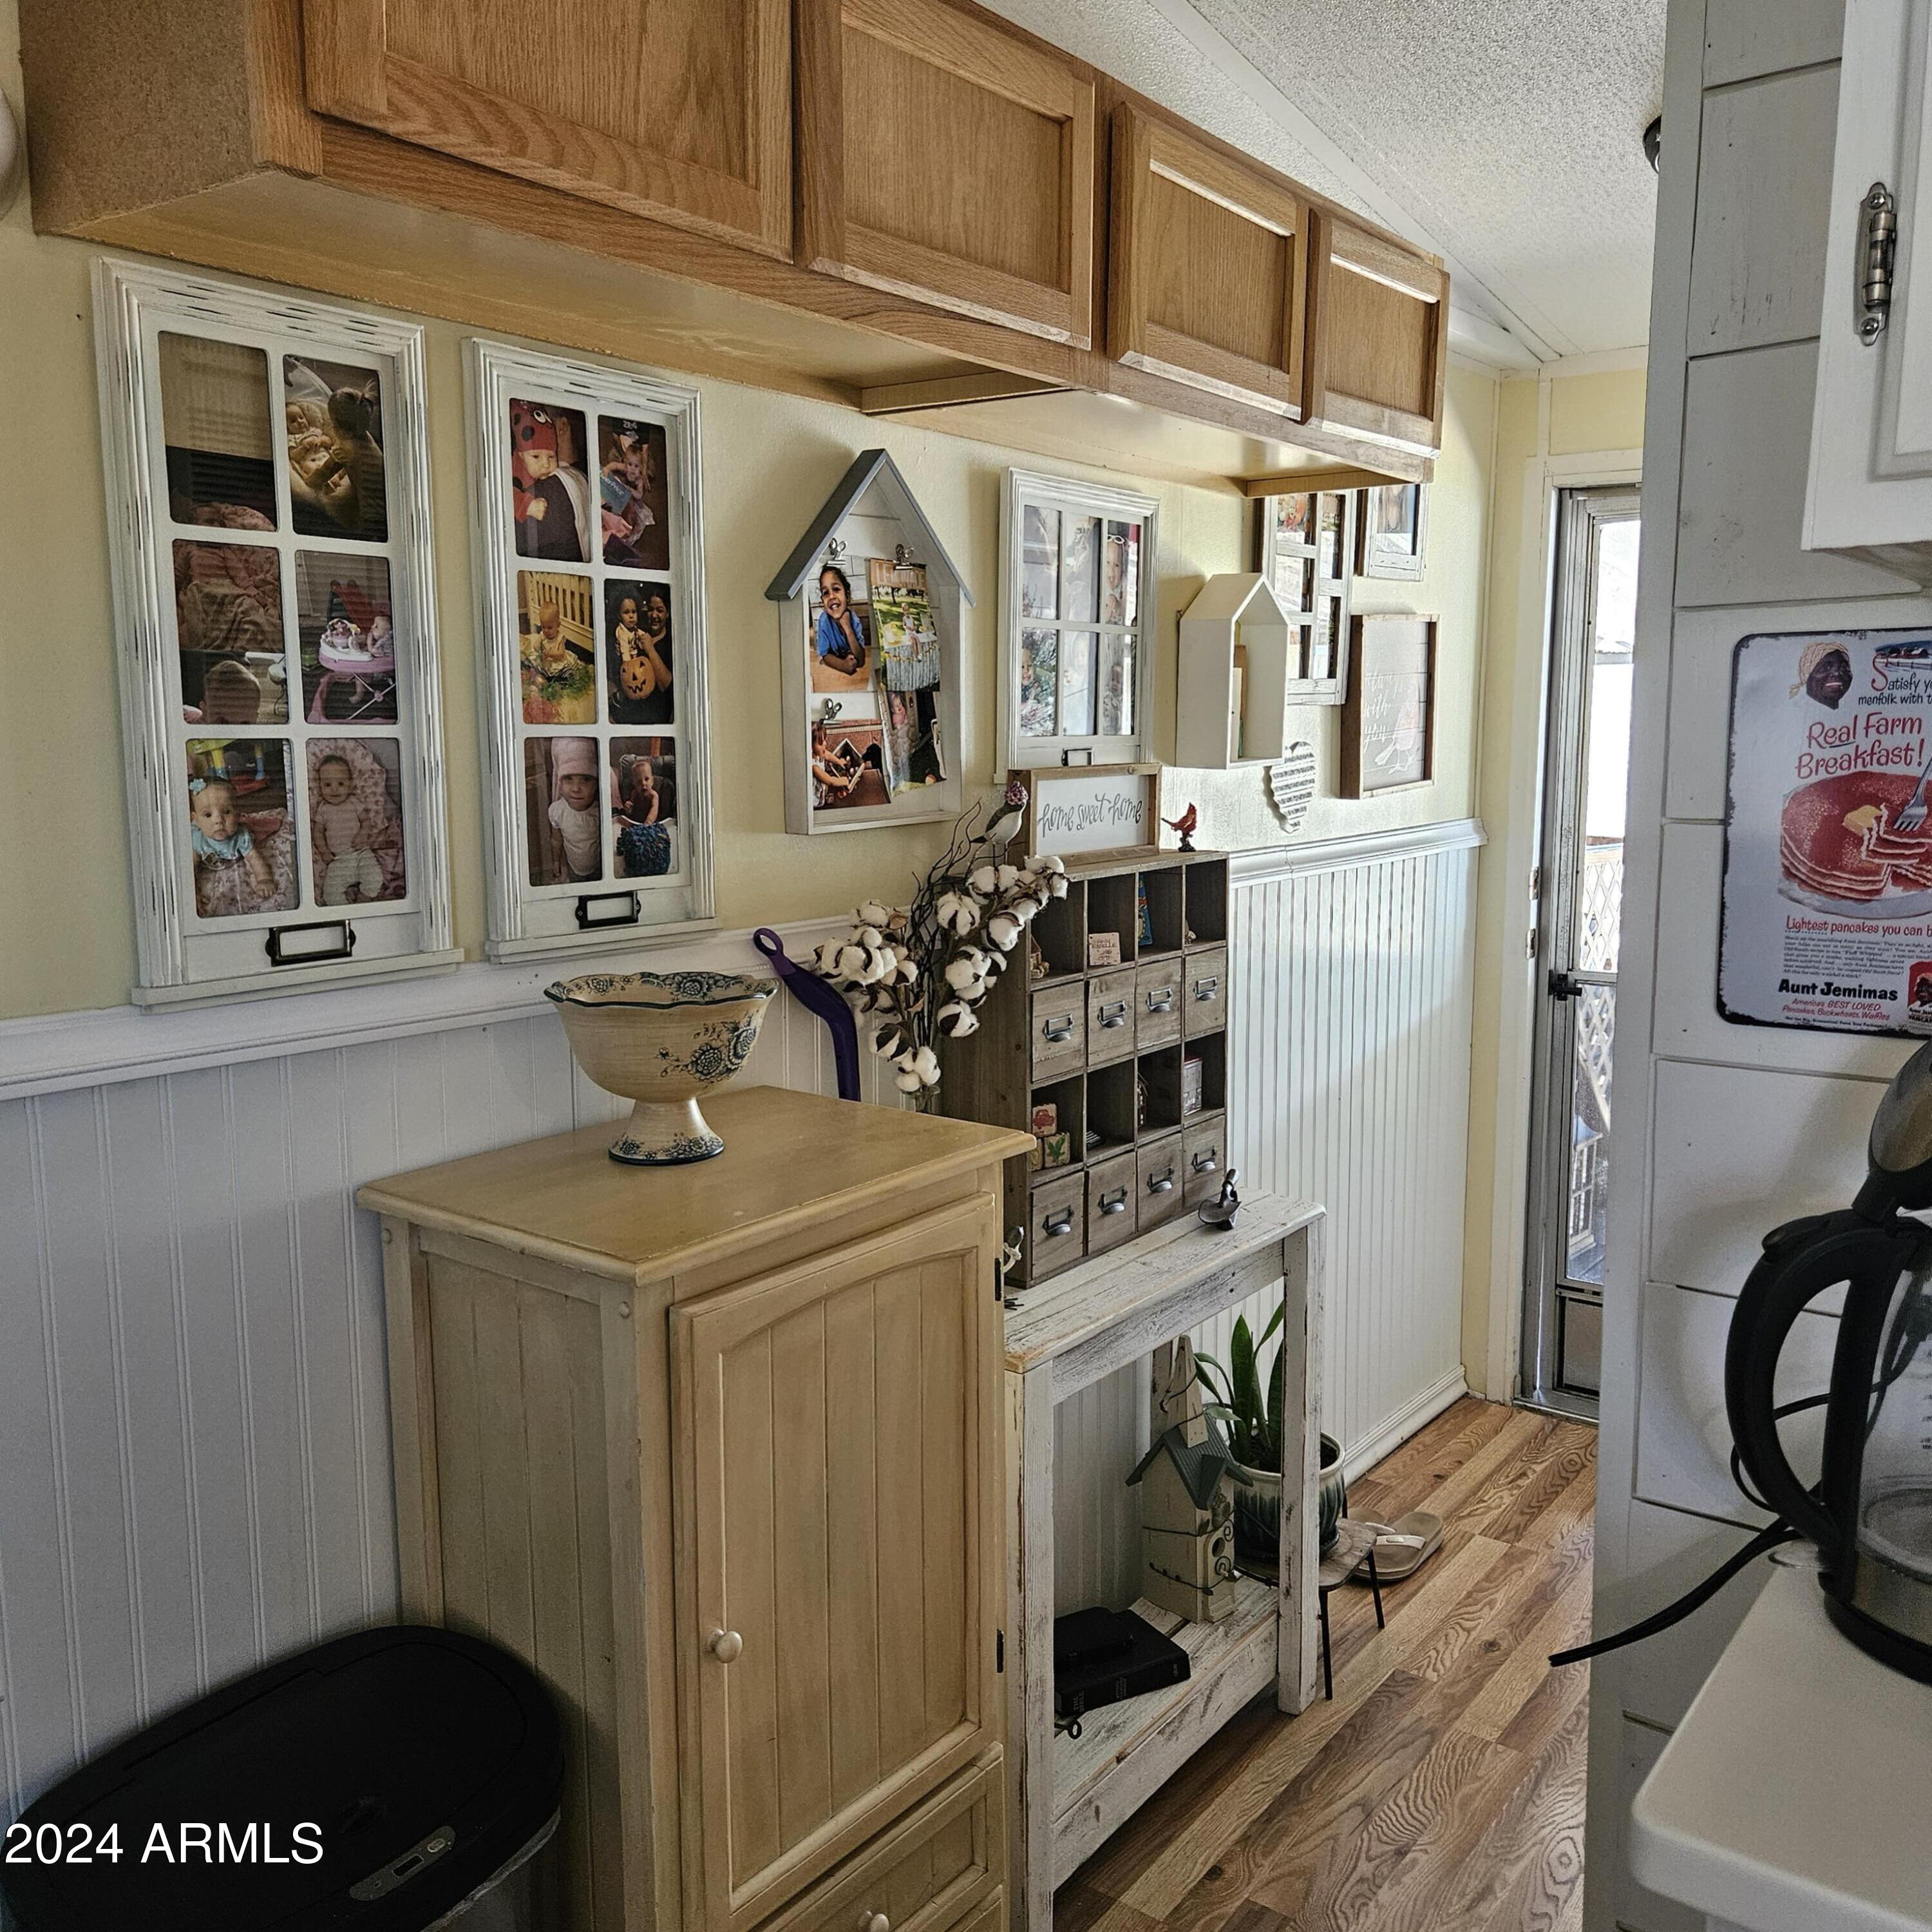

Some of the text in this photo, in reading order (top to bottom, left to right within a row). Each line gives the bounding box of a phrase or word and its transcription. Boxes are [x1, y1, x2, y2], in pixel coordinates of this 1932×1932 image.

[1871, 652, 1920, 694] Satisfy
[1858, 692, 1897, 706] menfolk
[1900, 692, 1923, 705] with
[1806, 712, 1922, 748] Real Farm
[1795, 739, 1925, 779] Breakfast!
[1037, 793, 1142, 838] home sweet home
[1786, 914, 1828, 933] Lightest
[1830, 921, 1879, 935] pancakes
[1882, 925, 1901, 938] you
[1903, 927, 1923, 936] can
[1778, 979, 1899, 1001] Aunt Jemimas
[1828, 999, 1850, 1009] BEST
[1852, 1001, 1881, 1011] LOVED
[1861, 1011, 1891, 1021] Waffles
